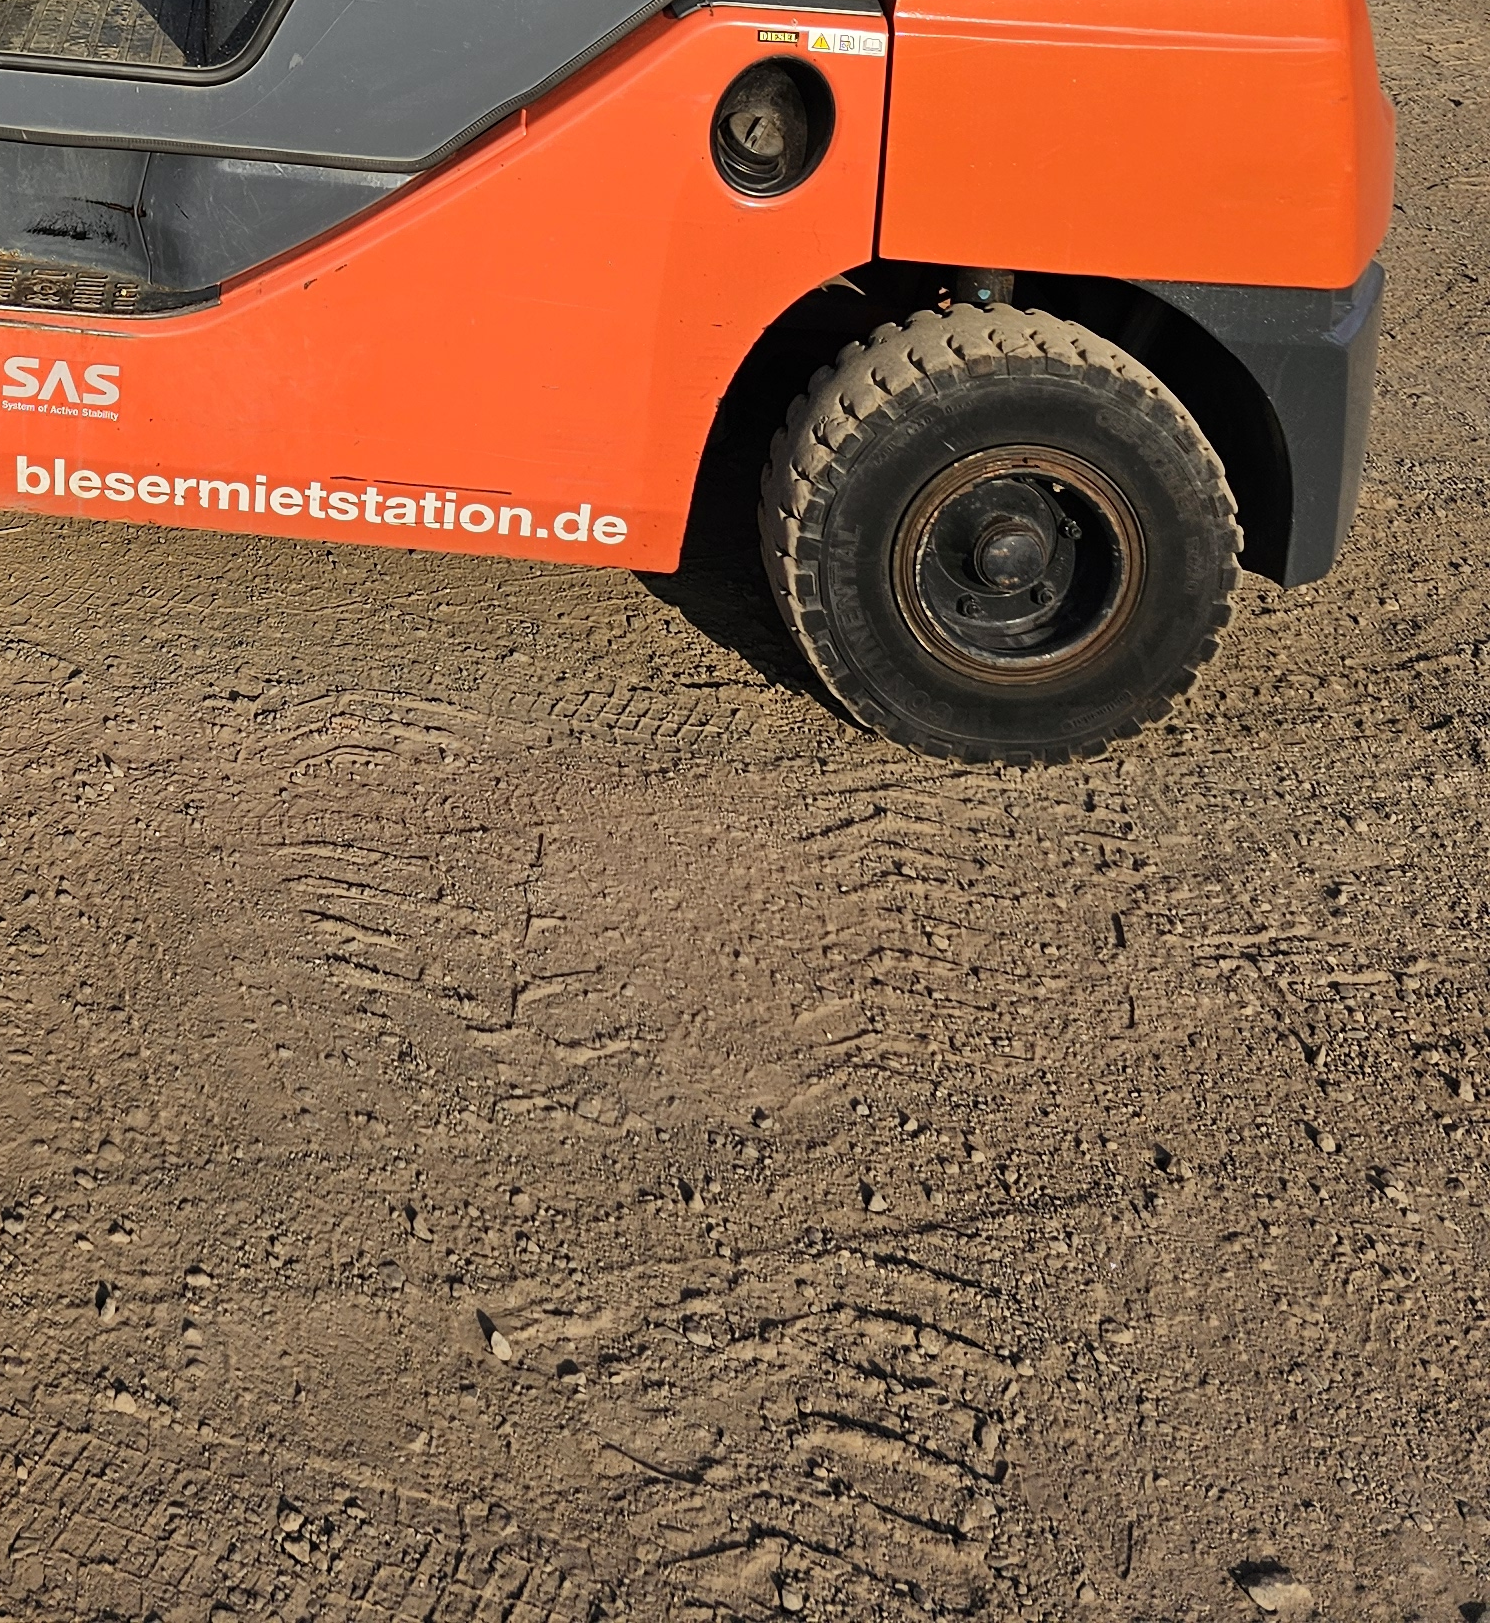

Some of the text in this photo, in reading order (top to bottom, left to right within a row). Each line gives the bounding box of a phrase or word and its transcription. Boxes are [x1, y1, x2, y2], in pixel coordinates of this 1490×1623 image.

[759, 31, 798, 43] DIESEL
[2, 356, 120, 406] SAS
[2, 400, 118, 421] System of Active Stability
[15, 456, 628, 545] blesermietstation.de
[828, 524, 954, 729] CONTINENTAL
